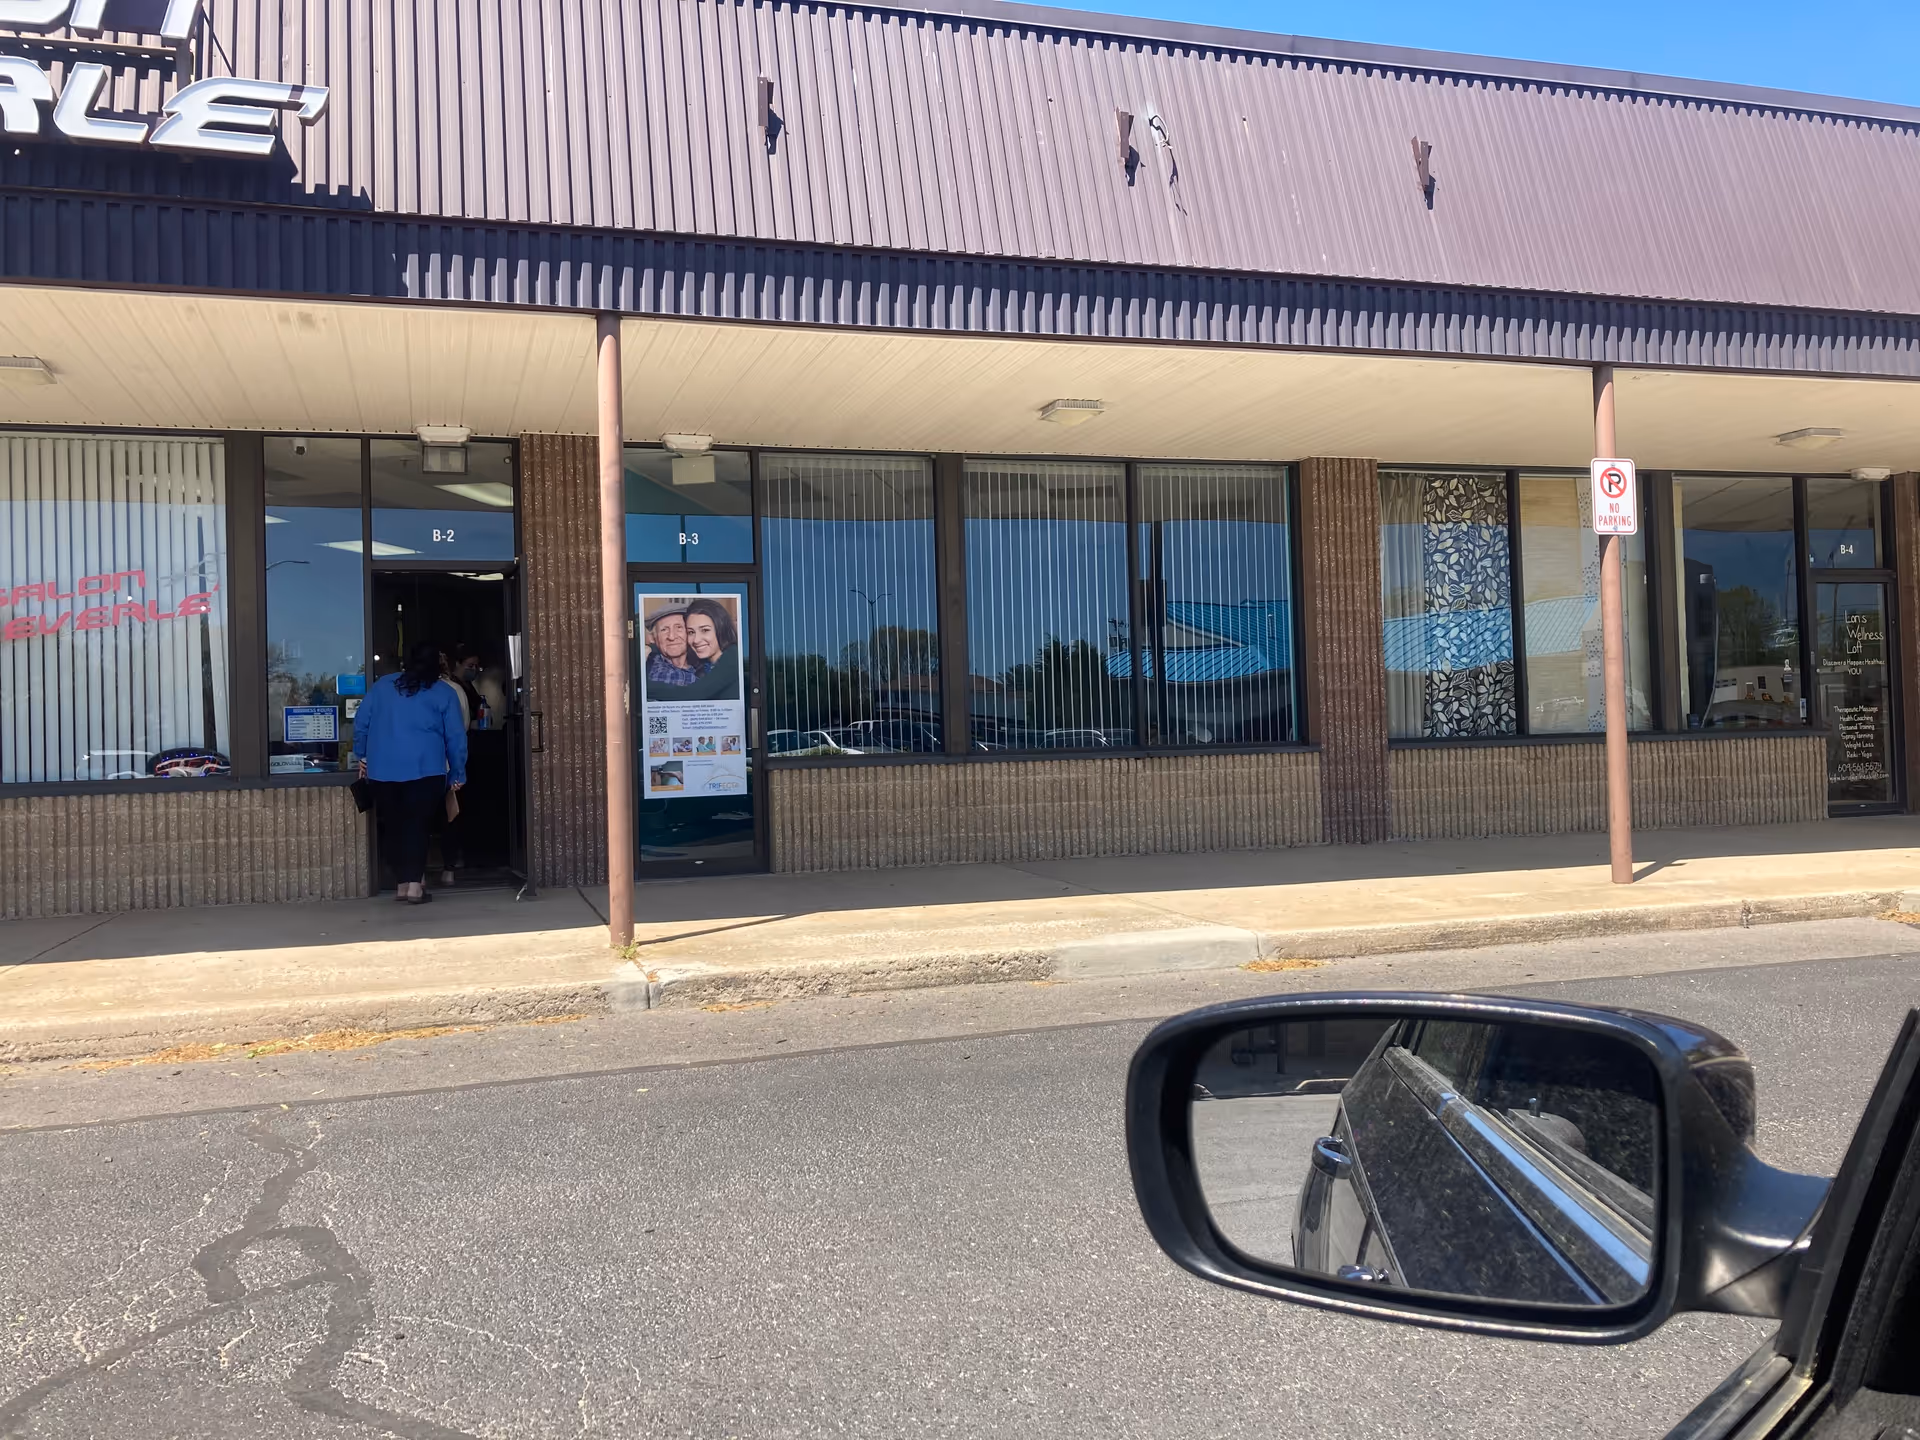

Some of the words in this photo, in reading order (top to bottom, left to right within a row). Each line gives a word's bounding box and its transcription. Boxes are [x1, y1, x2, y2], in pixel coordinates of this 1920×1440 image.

[1609, 503, 1620, 514] NO
[1599, 515, 1632, 526] PARKING
[433, 529, 454, 541] B-2
[679, 533, 698, 544] B-3
[1840, 545, 1853, 554] B-4
[0, 570, 146, 607] ALON
[1846, 625, 1884, 640] Wellness
[1846, 641, 1862, 654] Loft
[1853, 714, 1873, 722] Coaching
[1841, 732, 1855, 740] Spray
